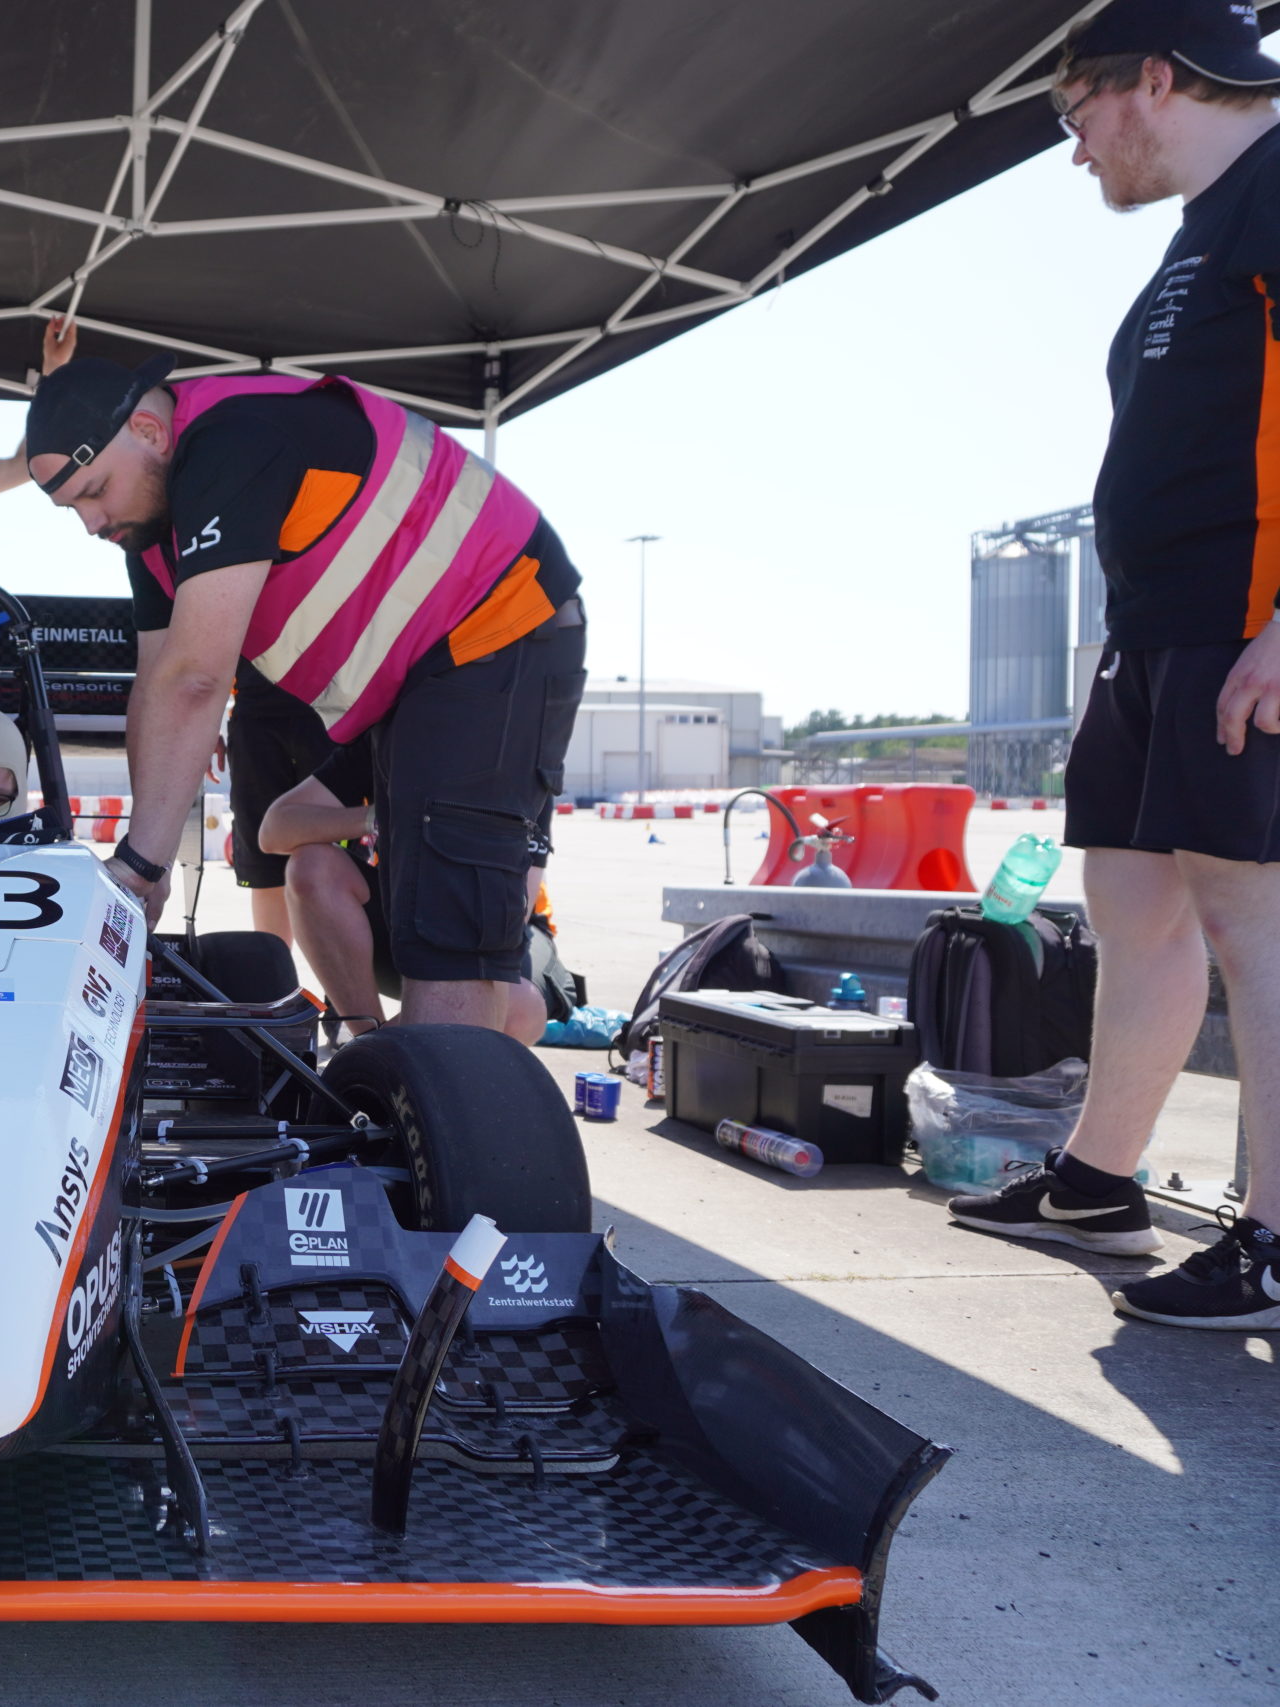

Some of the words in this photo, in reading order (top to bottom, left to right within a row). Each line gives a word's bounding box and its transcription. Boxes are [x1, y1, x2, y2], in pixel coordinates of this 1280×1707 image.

[9, 627, 128, 643] EINMETALL
[82, 965, 112, 1018] GWJ
[104, 990, 126, 1049] TECHNOLOGY
[35, 1137, 90, 1268] Ansys
[67, 1231, 119, 1350] OPUS
[488, 1296, 575, 1308] Zentralwerkstatt
[299, 1322, 376, 1335] VISHAY
